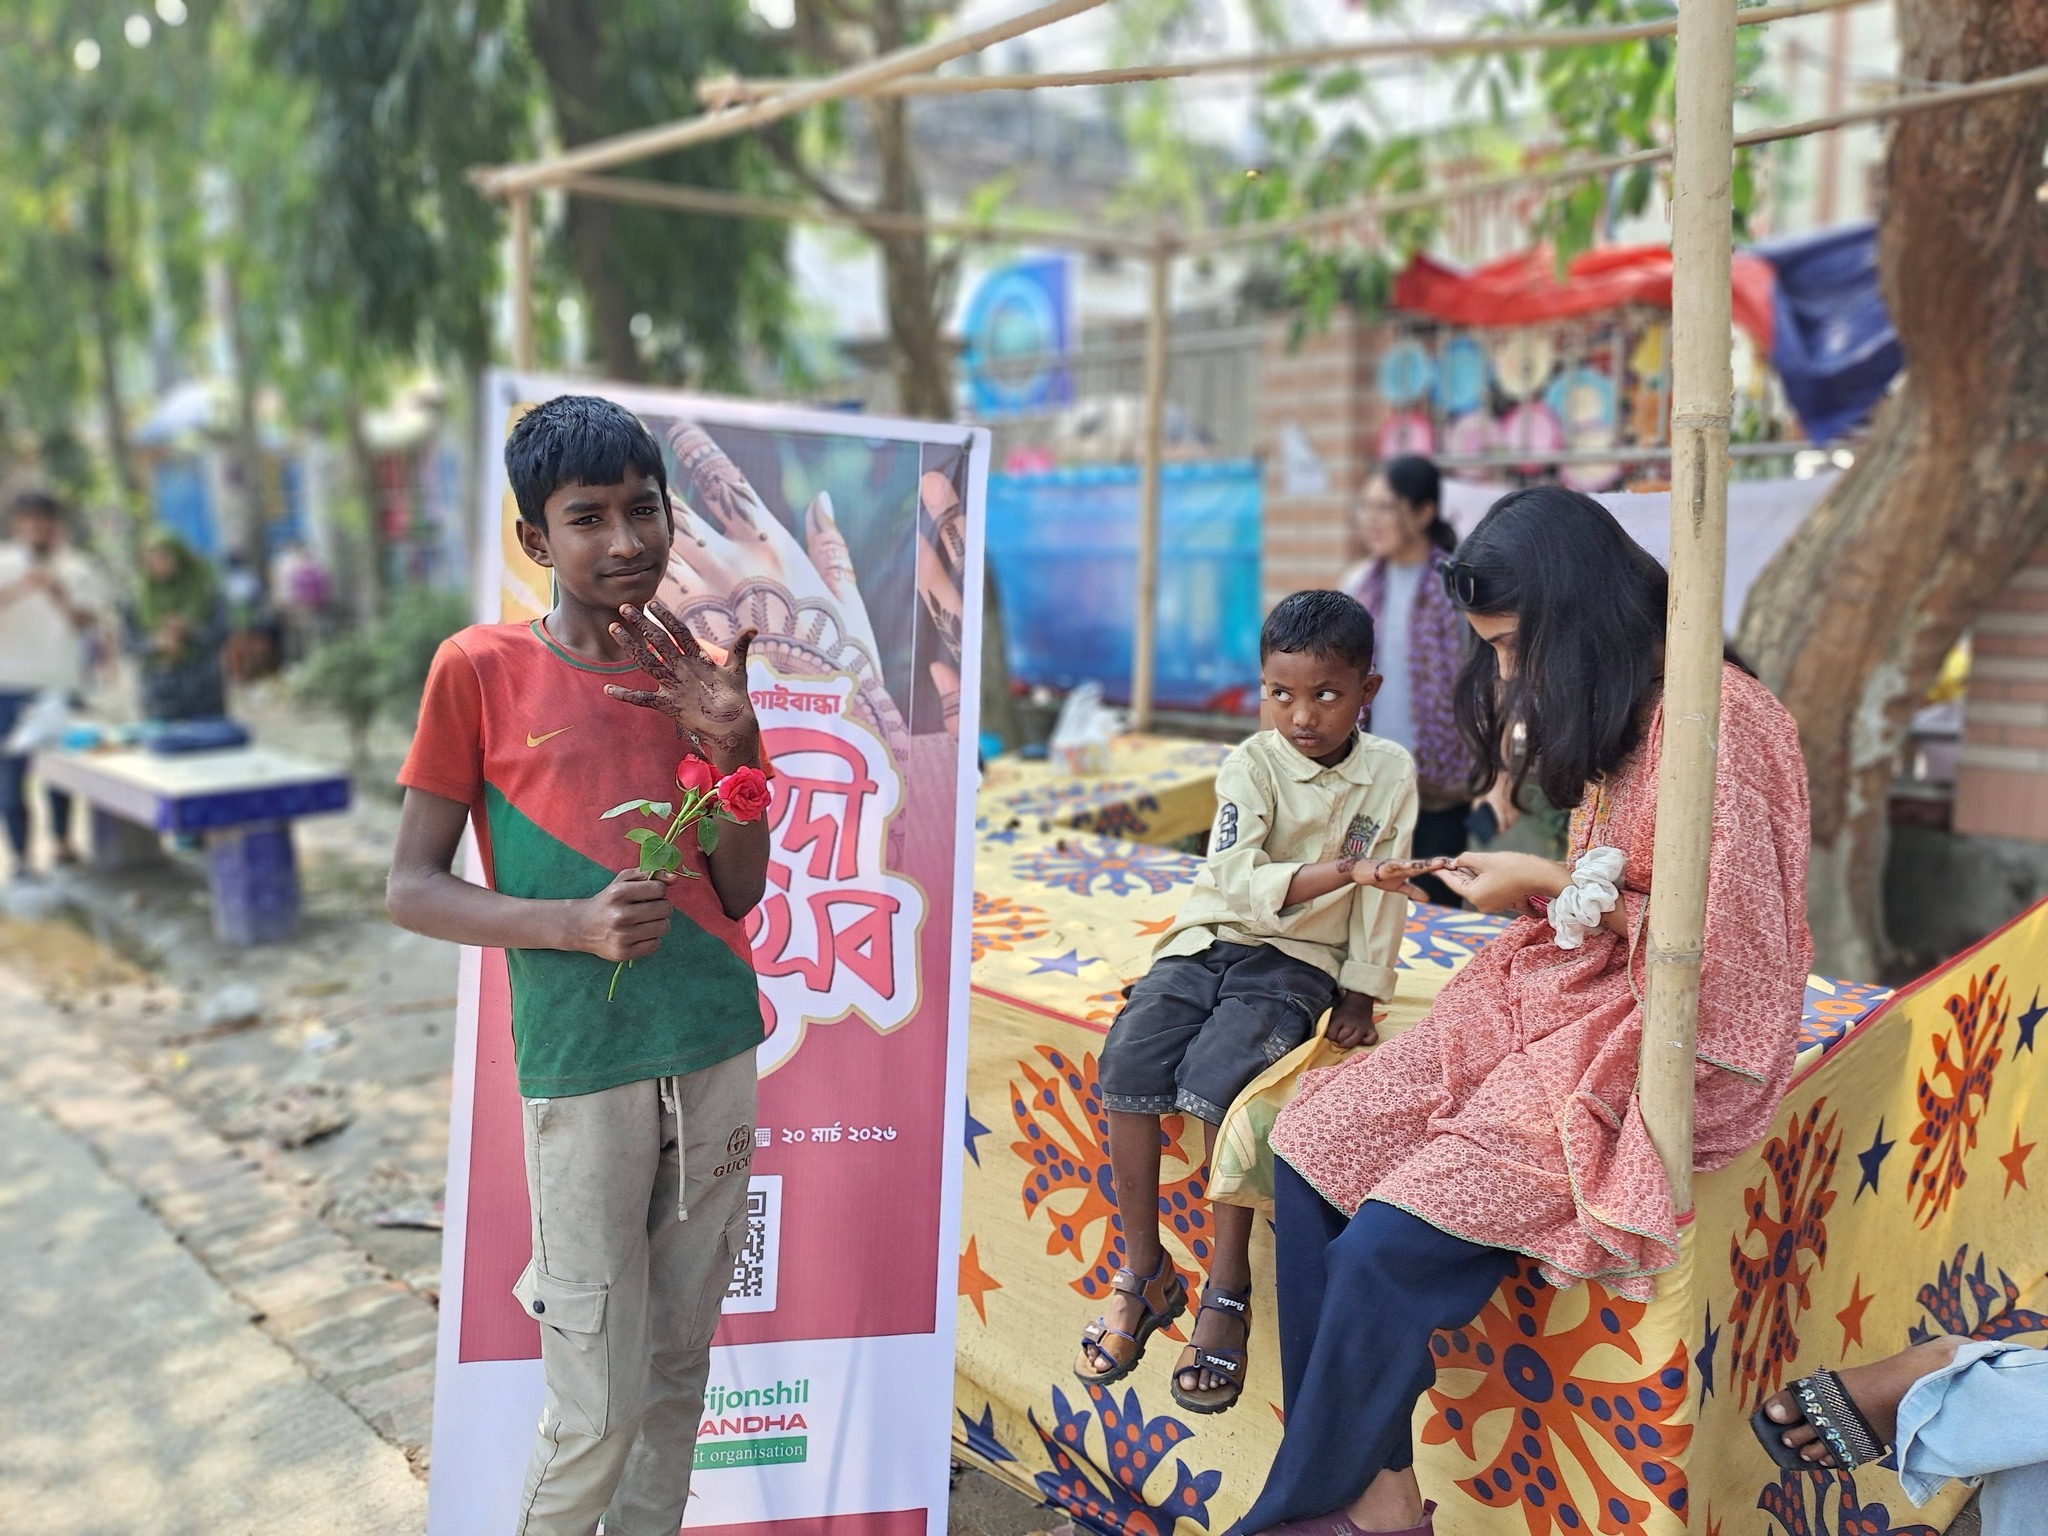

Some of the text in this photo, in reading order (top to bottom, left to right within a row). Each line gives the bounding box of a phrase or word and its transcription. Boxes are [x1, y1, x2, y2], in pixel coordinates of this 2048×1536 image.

[781, 1121, 898, 1144] ২০ মার্চ ২০২৬
[704, 1379, 809, 1416] ijonshil
[697, 1413, 807, 1438] ANDHA
[710, 1442, 803, 1464] organisation
